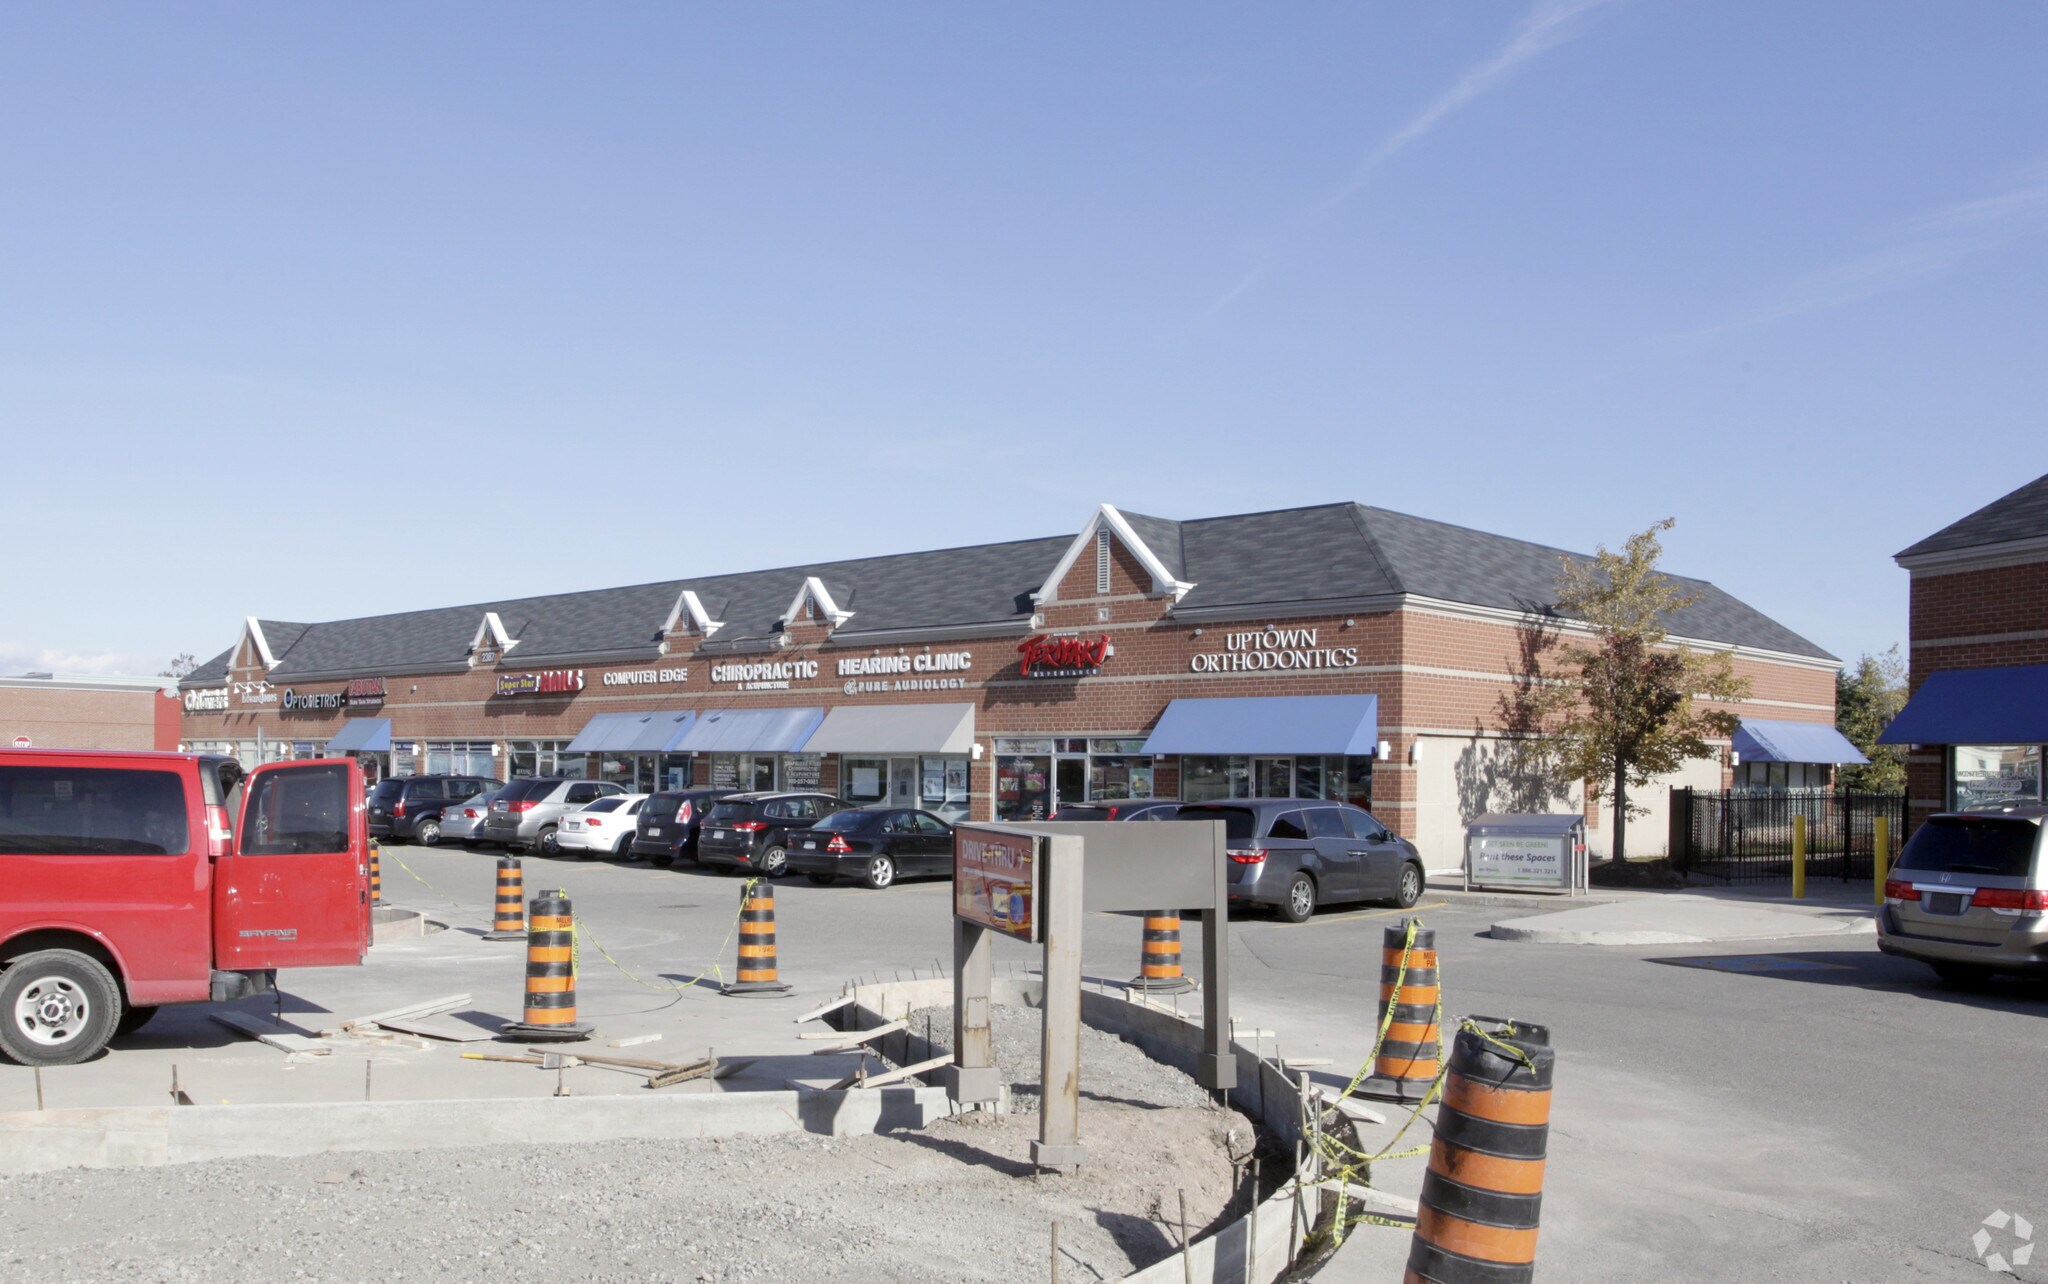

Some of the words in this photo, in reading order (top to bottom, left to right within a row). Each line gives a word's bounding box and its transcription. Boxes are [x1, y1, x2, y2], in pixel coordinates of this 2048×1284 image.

[1227, 628, 1317, 651] UPTOWN
[838, 655, 911, 676] HEARING
[913, 651, 972, 672] CLINIC
[1017, 633, 1111, 676] TERIYAKI
[1191, 648, 1358, 672] ORTHODONTICS
[500, 680, 519, 690] Super
[521, 679, 535, 688] Star
[540, 670, 583, 692] NAILS
[603, 670, 657, 685] COMPUTER
[659, 667, 688, 682] EDGE
[711, 660, 818, 682] CHIROPRACTIC
[858, 681, 889, 692] PURE
[894, 678, 966, 691] AUDIOLOGY
[284, 688, 341, 709] OPTOMETRIST
[1501, 851, 1525, 862] these
[1526, 852, 1556, 863] Spaces
[239, 928, 297, 937] SAVANA
